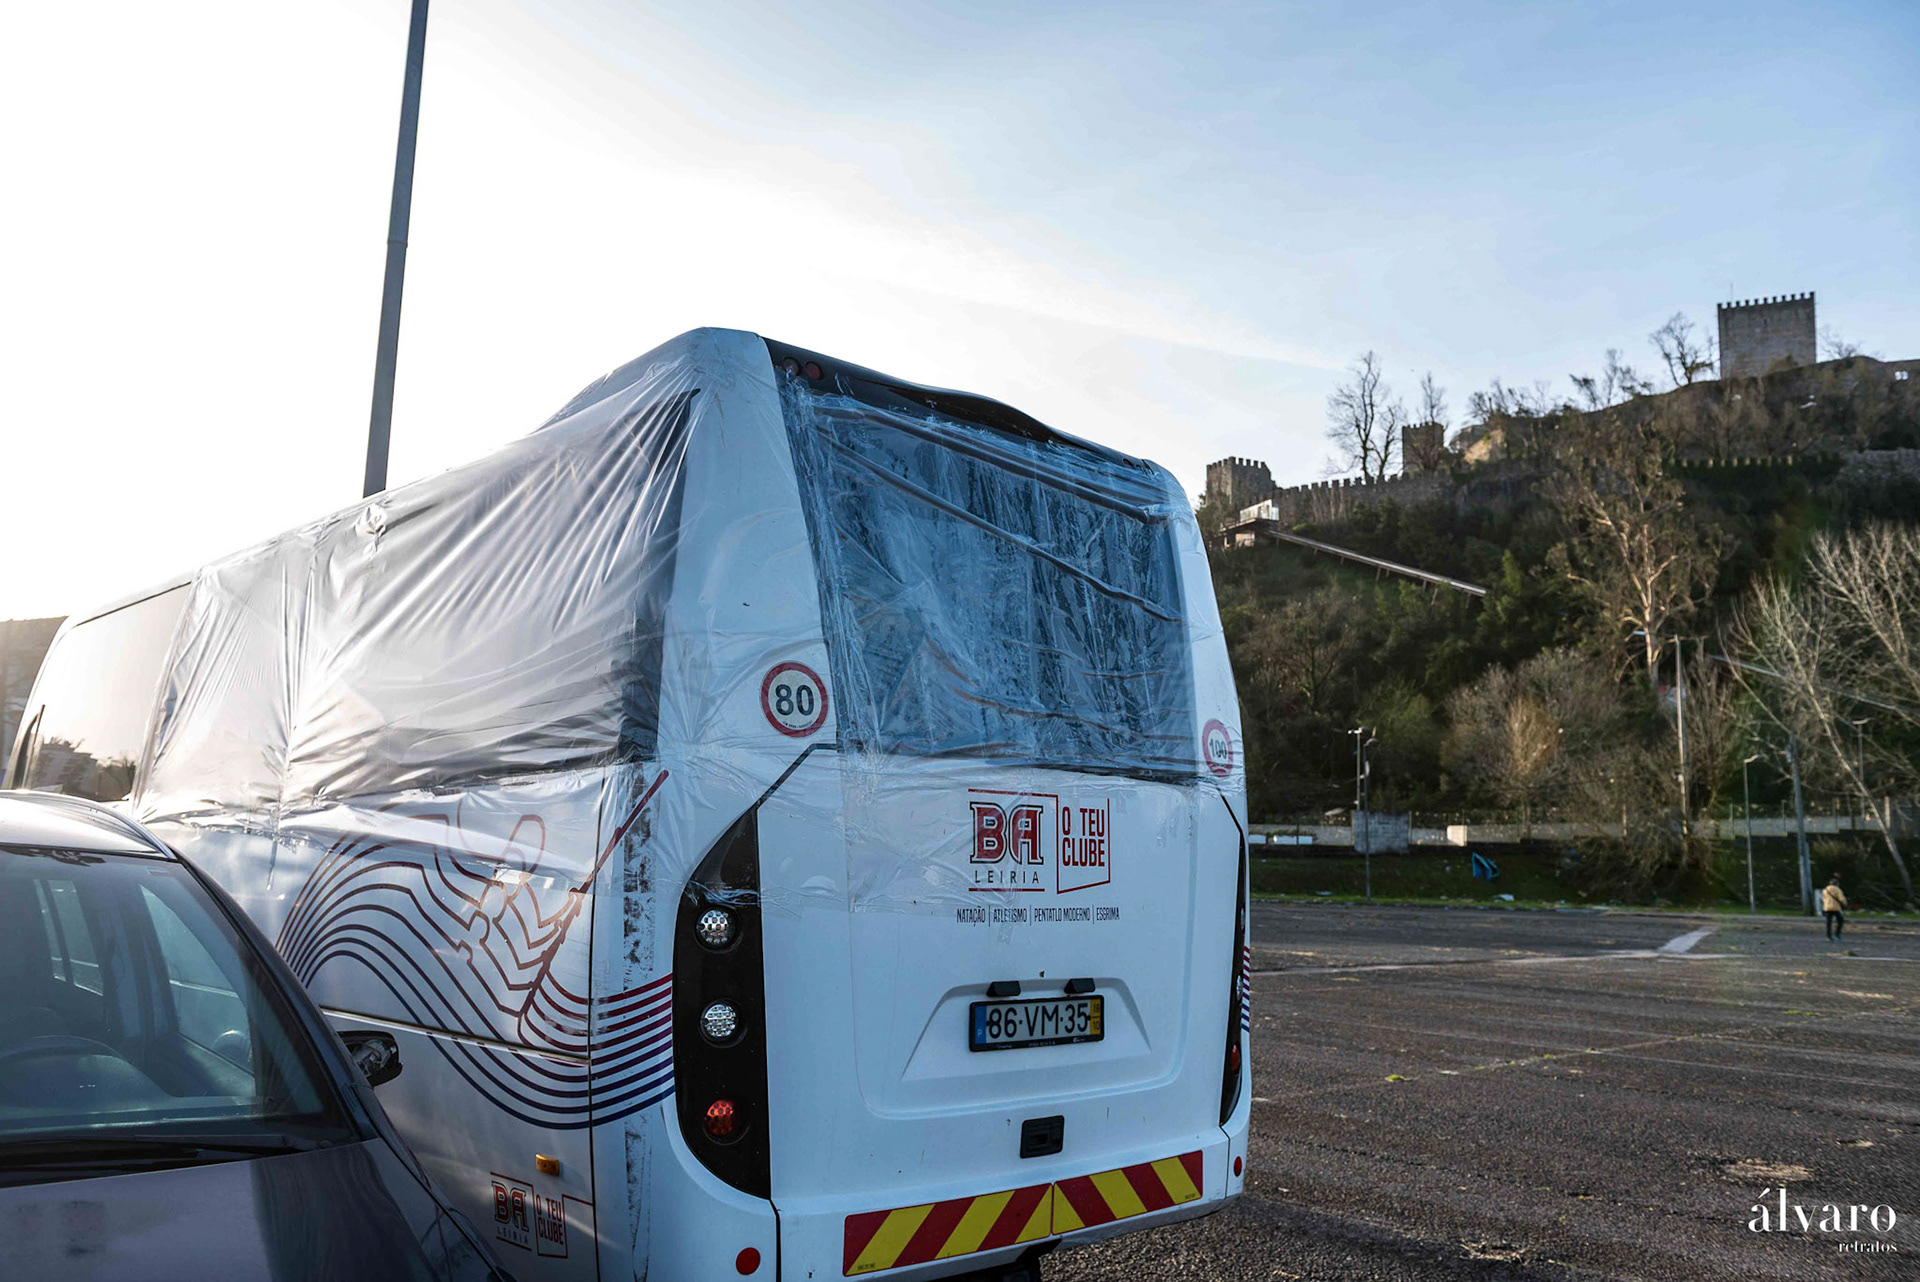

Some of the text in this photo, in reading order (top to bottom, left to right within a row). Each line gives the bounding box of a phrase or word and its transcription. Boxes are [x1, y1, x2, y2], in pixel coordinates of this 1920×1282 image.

[775, 684, 815, 717] 80
[1210, 739, 1227, 760] 100
[970, 801, 1044, 865] BA
[1062, 806, 1105, 837] O TEU
[1062, 837, 1105, 867] CLUBE
[975, 870, 1040, 884] LEIRIA
[957, 905, 1120, 927] NATAÇÃO ATLETISMO PENTATLO MODERNO ESGRIMA
[491, 1180, 530, 1233] BA
[536, 1194, 562, 1222] O TEU
[538, 1216, 564, 1245] CLUBE
